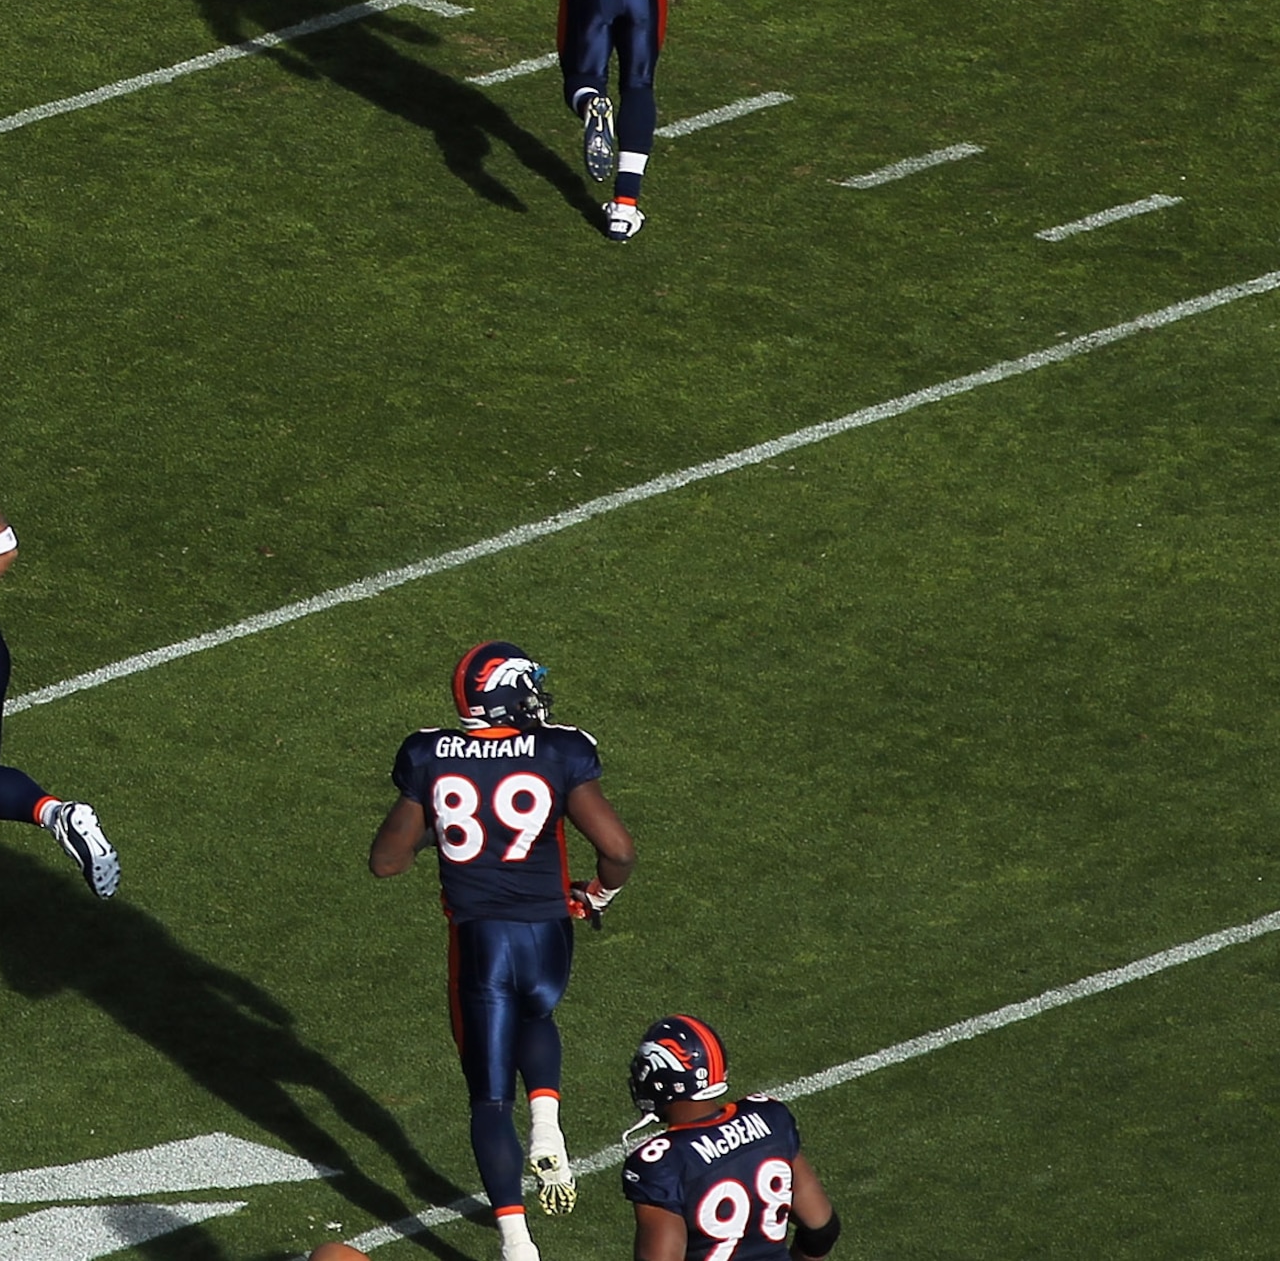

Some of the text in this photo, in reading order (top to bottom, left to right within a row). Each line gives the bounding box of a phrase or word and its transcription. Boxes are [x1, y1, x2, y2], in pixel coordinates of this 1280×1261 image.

[435, 734, 535, 759] GRAHAM
[431, 772, 555, 864] 89
[690, 1112, 771, 1164] McBEAN
[697, 1157, 794, 1261] 98
